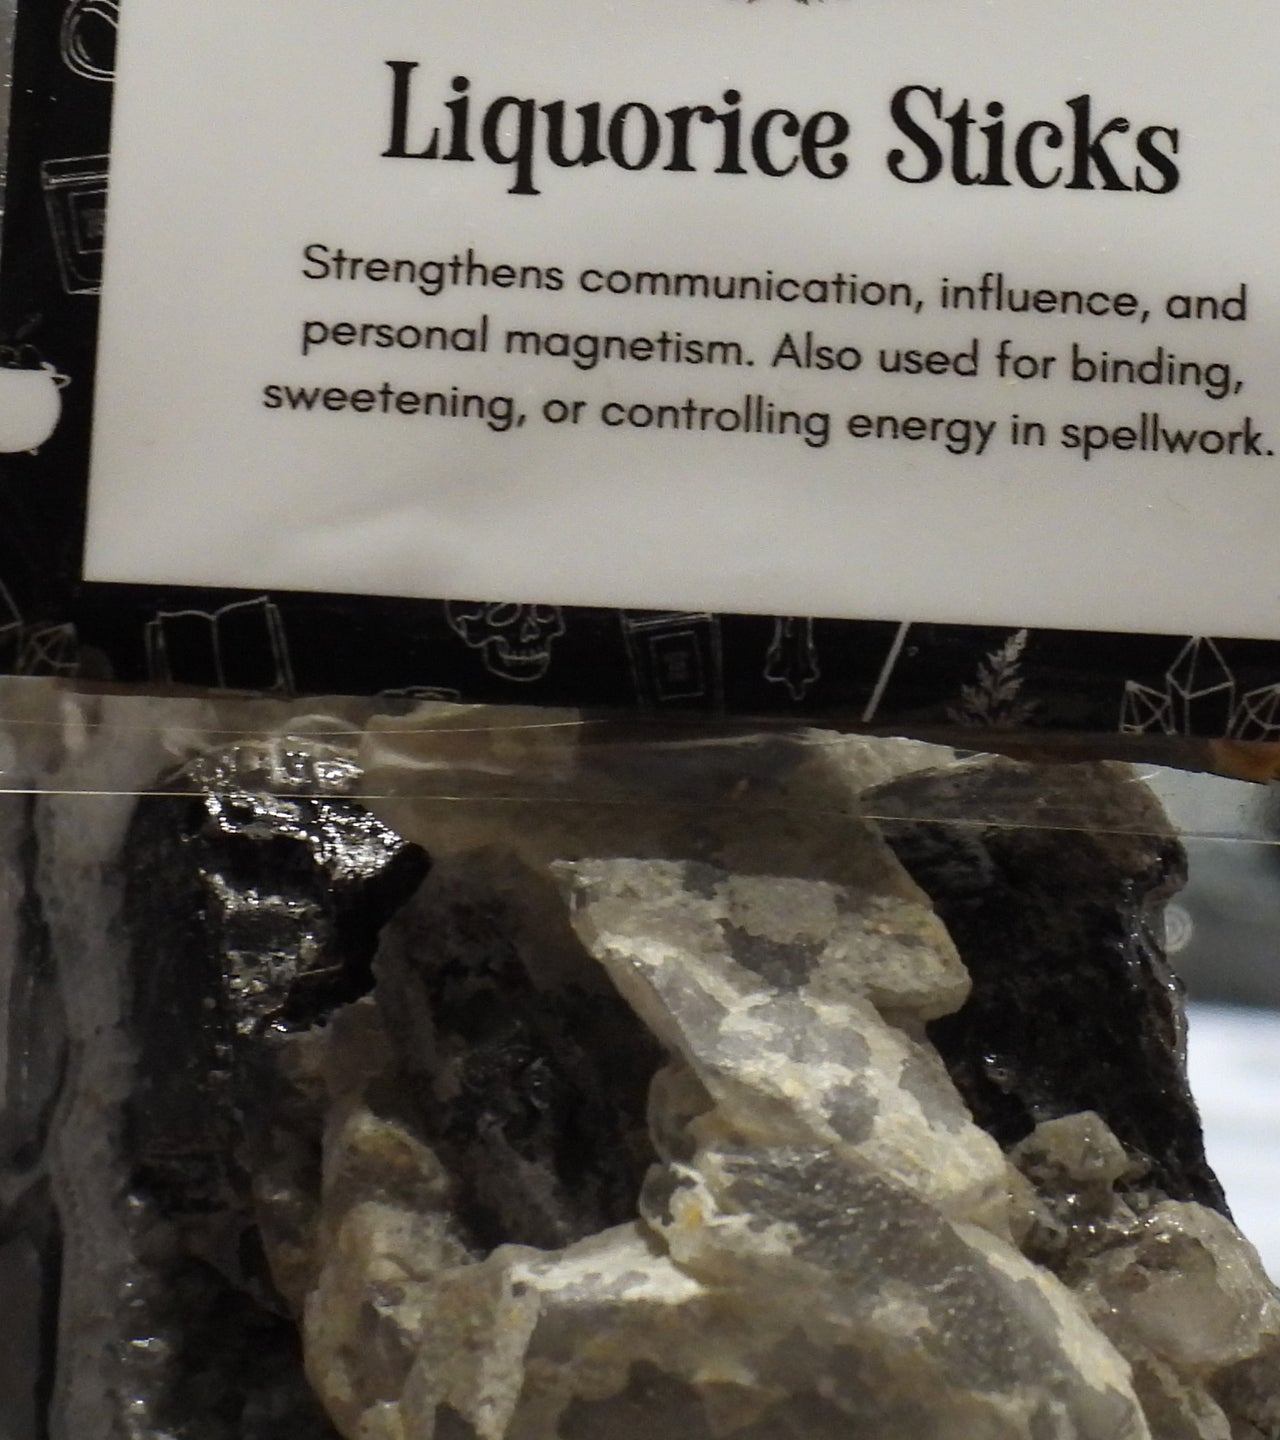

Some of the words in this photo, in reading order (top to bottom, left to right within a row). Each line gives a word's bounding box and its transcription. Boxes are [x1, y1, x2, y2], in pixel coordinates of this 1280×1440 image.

[379, 60, 851, 196] Liquorice
[886, 84, 1181, 195] Sticks
[302, 243, 565, 296] Strengthens
[578, 266, 925, 314] communication,
[940, 272, 1151, 325] influence,
[1165, 283, 1248, 322] and
[301, 313, 489, 357] personal
[504, 330, 755, 372] magnetism.
[770, 331, 864, 372] Also
[878, 337, 980, 378] used
[994, 338, 1058, 381] for
[1070, 341, 1245, 400] binding,
[262, 381, 528, 432] sweetening,
[541, 398, 588, 425] or
[599, 393, 832, 449] controlling
[845, 413, 998, 457] energy
[1010, 413, 1047, 447] in
[1060, 411, 1275, 463] spellwork.
